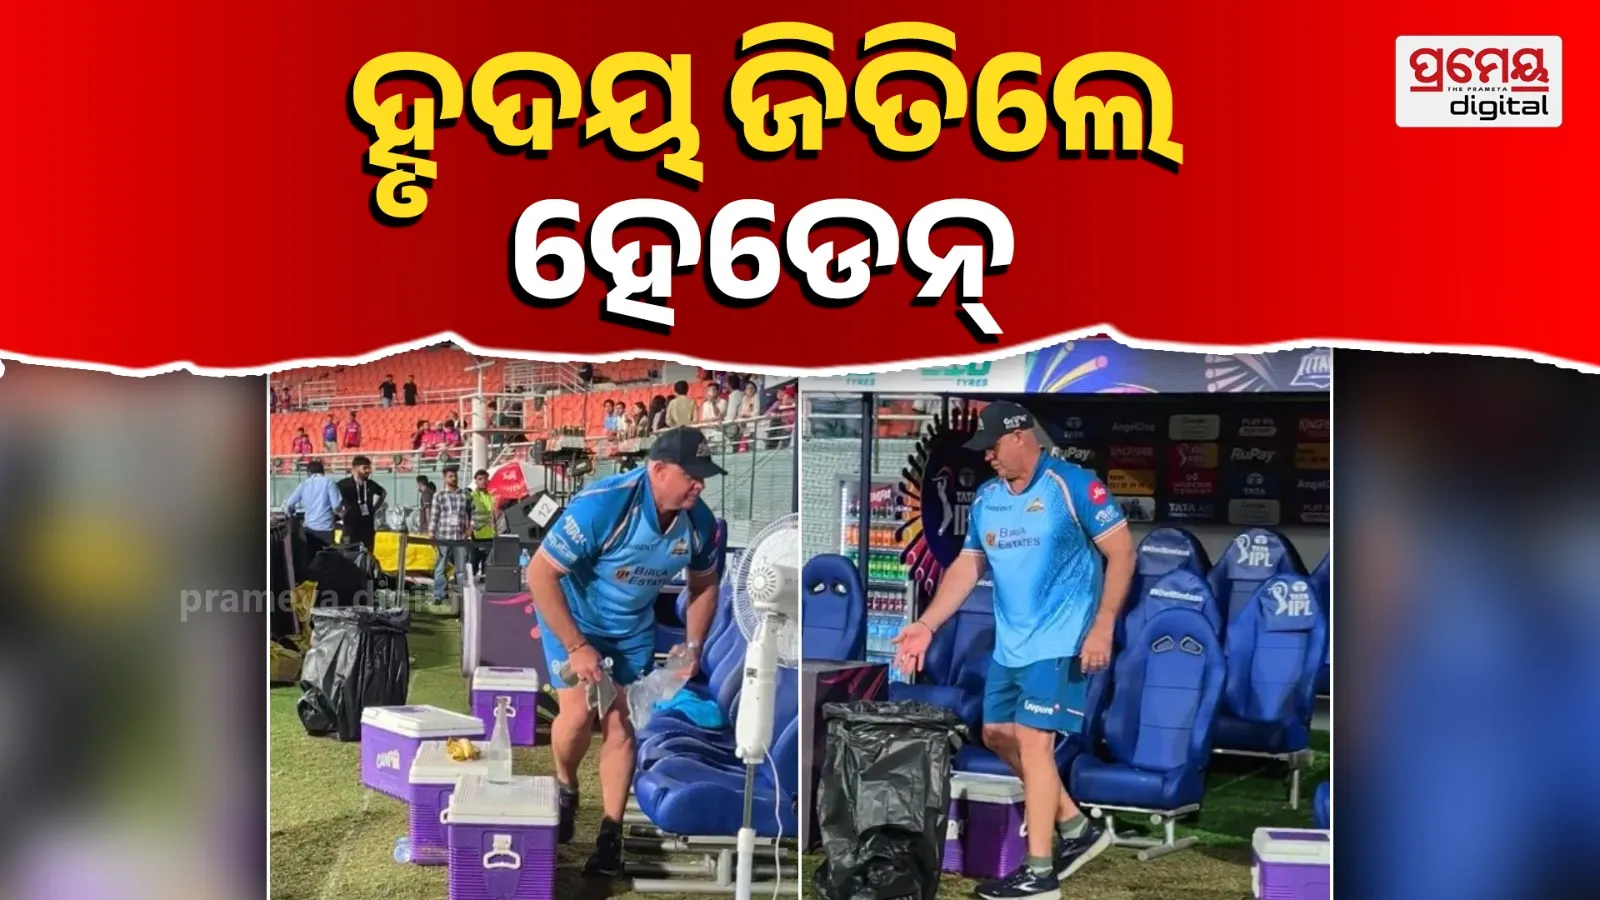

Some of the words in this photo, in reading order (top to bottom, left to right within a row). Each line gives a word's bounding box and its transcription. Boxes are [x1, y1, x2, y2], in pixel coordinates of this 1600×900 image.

[957, 378, 989, 387] TYRES
[1230, 447, 1275, 462] RuPay
[538, 502, 553, 518] 12
[953, 504, 971, 536] IP
[1248, 551, 1274, 567] IPL
[634, 566, 668, 577] BIRLA
[1287, 600, 1314, 617] IPL
